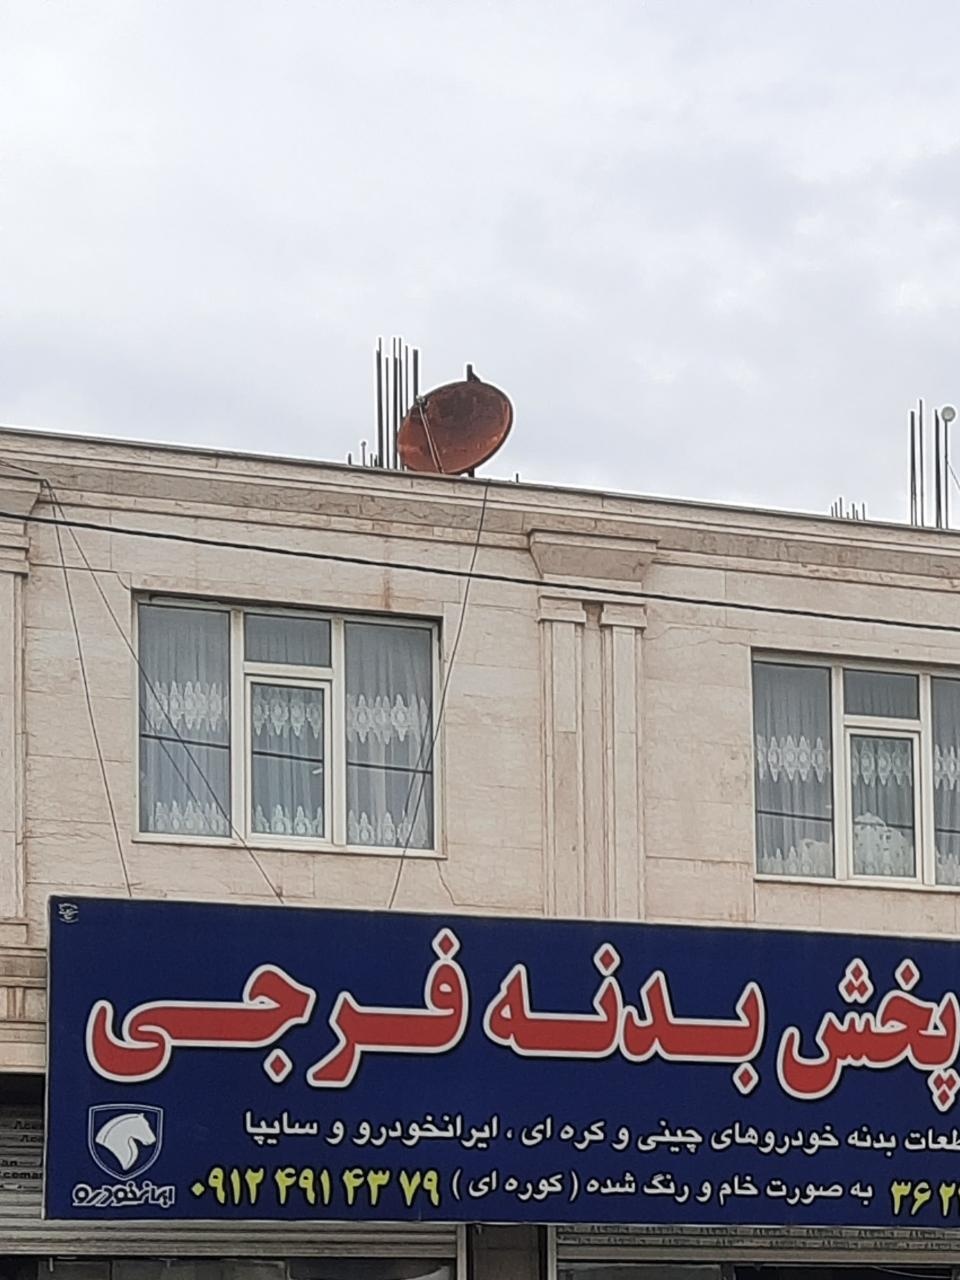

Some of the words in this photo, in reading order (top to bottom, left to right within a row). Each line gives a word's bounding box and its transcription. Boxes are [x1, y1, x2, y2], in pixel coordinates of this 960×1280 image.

[86, 928, 468, 1087] فرجی
[483, 943, 764, 1094] بدنه
[777, 958, 960, 1111] پخش
[246, 1111, 317, 1144] سایپا
[327, 1121, 343, 1144] و
[354, 1115, 497, 1147] ایرانخودرو
[522, 1117, 551, 1145] ای
[561, 1121, 604, 1149] کره
[613, 1127, 628, 1149] و
[638, 1121, 702, 1152] چینی
[712, 1123, 838, 1154] خودروهای
[848, 1127, 895, 1156] بدنه
[586, 1172, 635, 1194] شده
[644, 1174, 689, 1202] رنگ
[697, 1181, 712, 1201] و
[719, 1175, 758, 1205] خام
[766, 1180, 843, 1204] صورت
[850, 1182, 872, 1205] به
